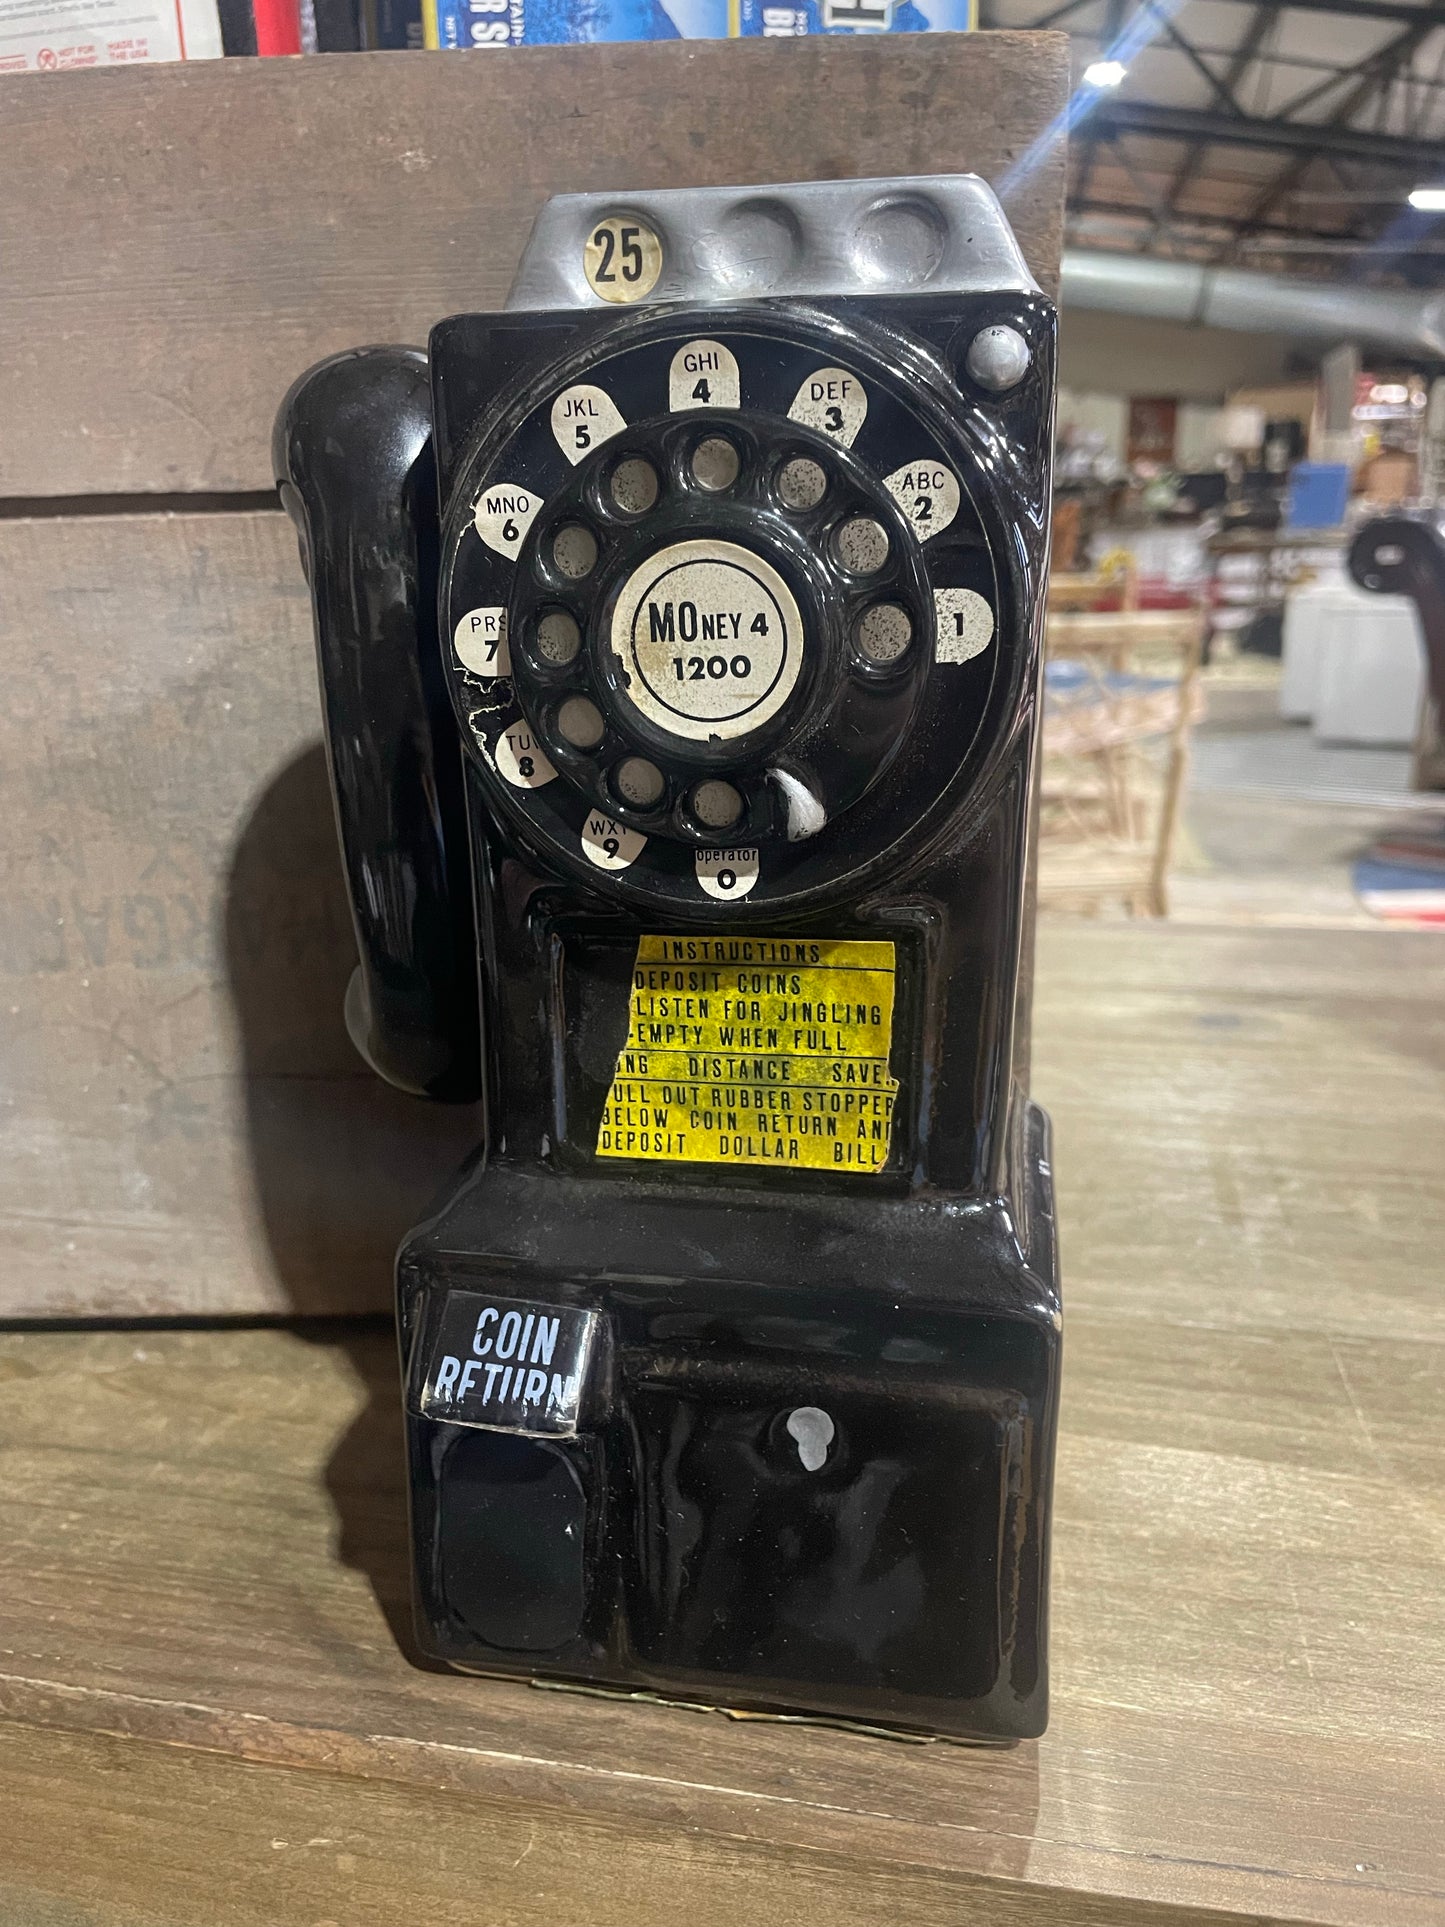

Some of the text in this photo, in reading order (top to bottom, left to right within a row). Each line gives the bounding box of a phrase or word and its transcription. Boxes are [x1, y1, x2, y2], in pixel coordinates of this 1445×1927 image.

[594, 227, 643, 283] 25
[684, 352, 719, 373] GHI
[692, 378, 712, 403] 4
[810, 380, 852, 401] DEF
[563, 399, 599, 418] JKL
[825, 406, 844, 432] 3
[575, 425, 591, 449] 5
[901, 471, 945, 491] ABC
[486, 496, 530, 515] MNO
[914, 496, 932, 520] 2
[502, 518, 519, 542] 6
[648, 601, 769, 642] MONEY 4
[953, 613, 964, 636] 1
[484, 640, 501, 662] 7
[673, 655, 751, 680] 1200
[519, 756, 535, 778] 8
[603, 838, 620, 859] 9
[696, 850, 758, 864] operator
[663, 941, 820, 963] INSTRUCTIONS
[635, 970, 801, 995] DEPOSIT COINS
[636, 997, 881, 1026] LISTEN FOR JINGLING
[720, 1027, 778, 1048] WHEN
[794, 1030, 847, 1051] FULL
[689, 1058, 791, 1081] DISTANCE
[663, 1086, 700, 1106] OUT
[712, 1089, 791, 1111] RUBBER
[602, 1107, 668, 1128] BELOW
[690, 1110, 738, 1131] COIN
[758, 1113, 837, 1137] RETURN
[603, 1131, 687, 1154] DEPOSIT
[720, 1136, 799, 1160] DOLLAR
[472, 1307, 561, 1366] COIN
[434, 1355, 578, 1417] RETURN
